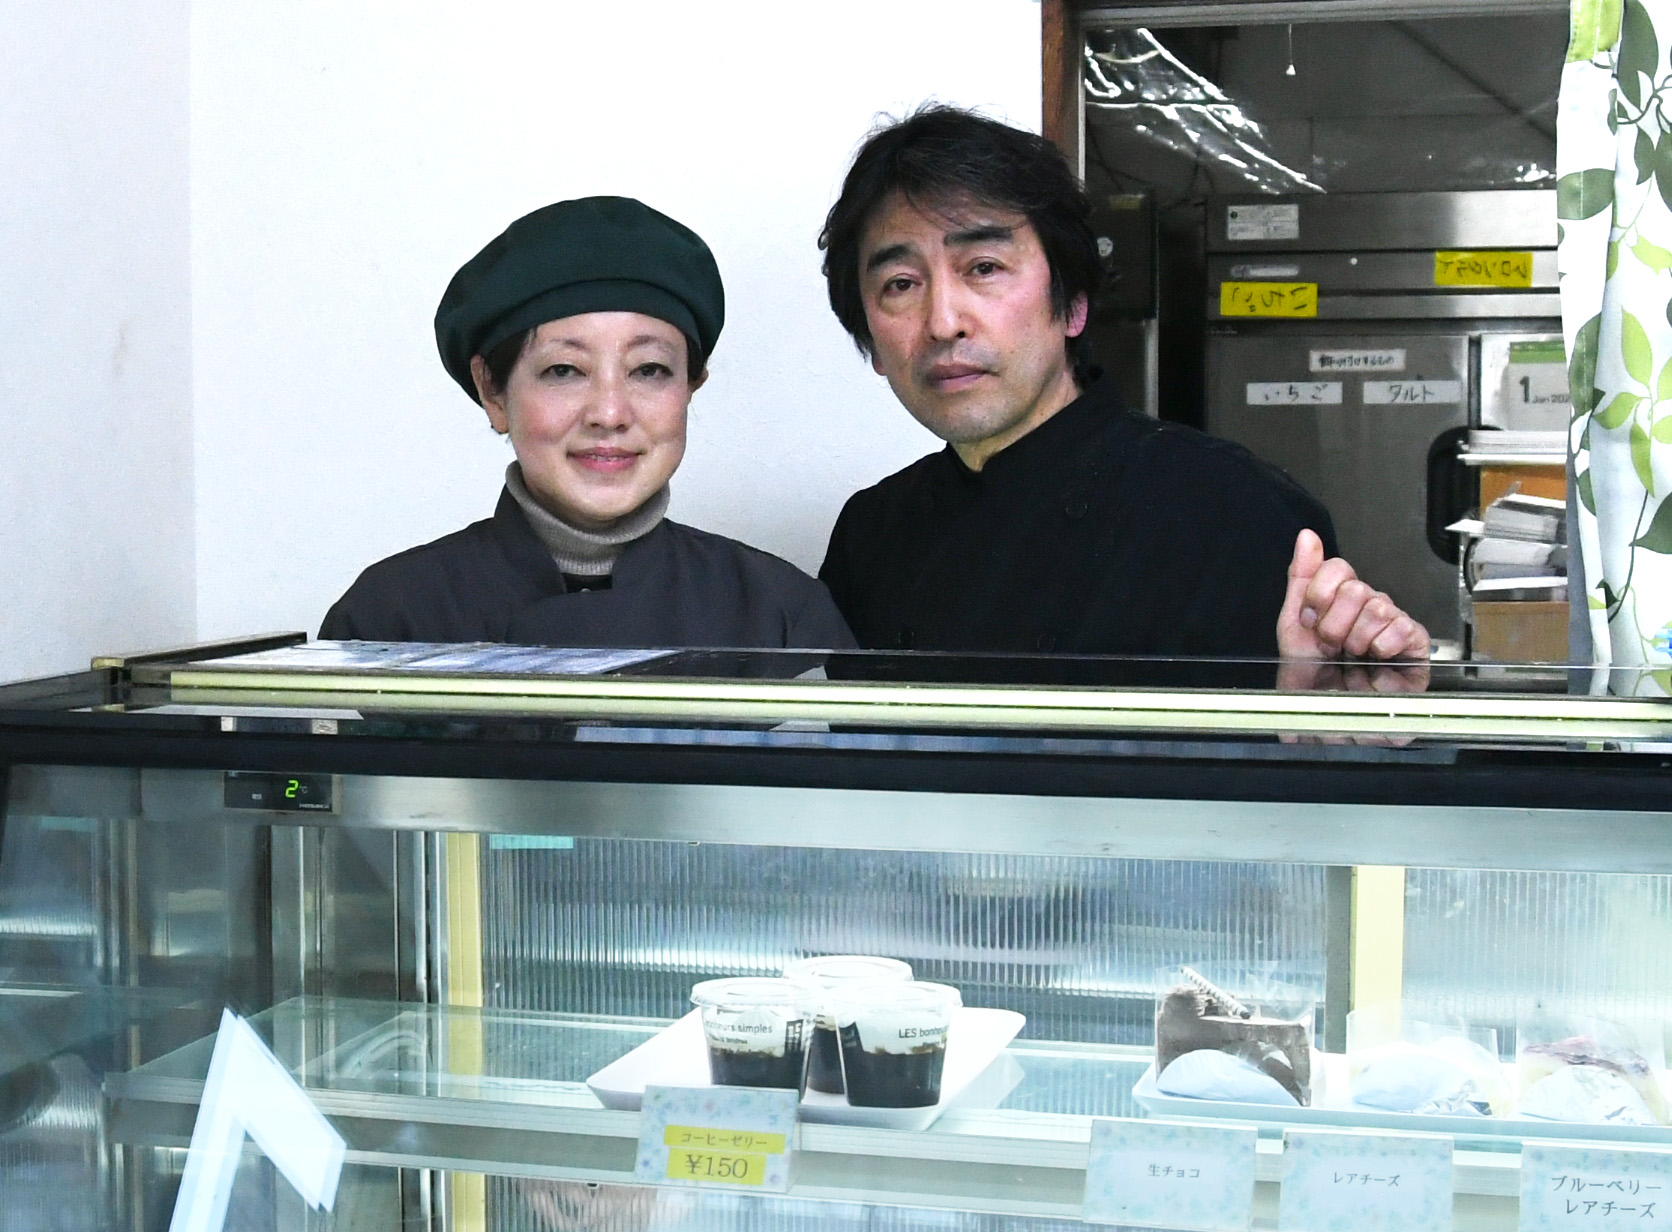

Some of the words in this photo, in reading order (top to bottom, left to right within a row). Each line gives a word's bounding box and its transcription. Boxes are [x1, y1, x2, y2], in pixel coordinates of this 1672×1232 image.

[1264, 383, 1329, 401] いちご
[1389, 384, 1435, 402] タルト
[1519, 376, 1530, 403] 1
[285, 779, 299, 798] 2
[737, 1023, 773, 1035] simples
[898, 1028, 917, 1038] LES
[681, 1133, 768, 1148] コーヒーゼリー
[685, 1154, 748, 1179] ¥150
[1148, 1163, 1200, 1178] 生チョコ
[1334, 1172, 1401, 1187] レアチーズ
[1551, 1176, 1662, 1195] ブルーベリー
[1566, 1199, 1656, 1219] レアチーズ
